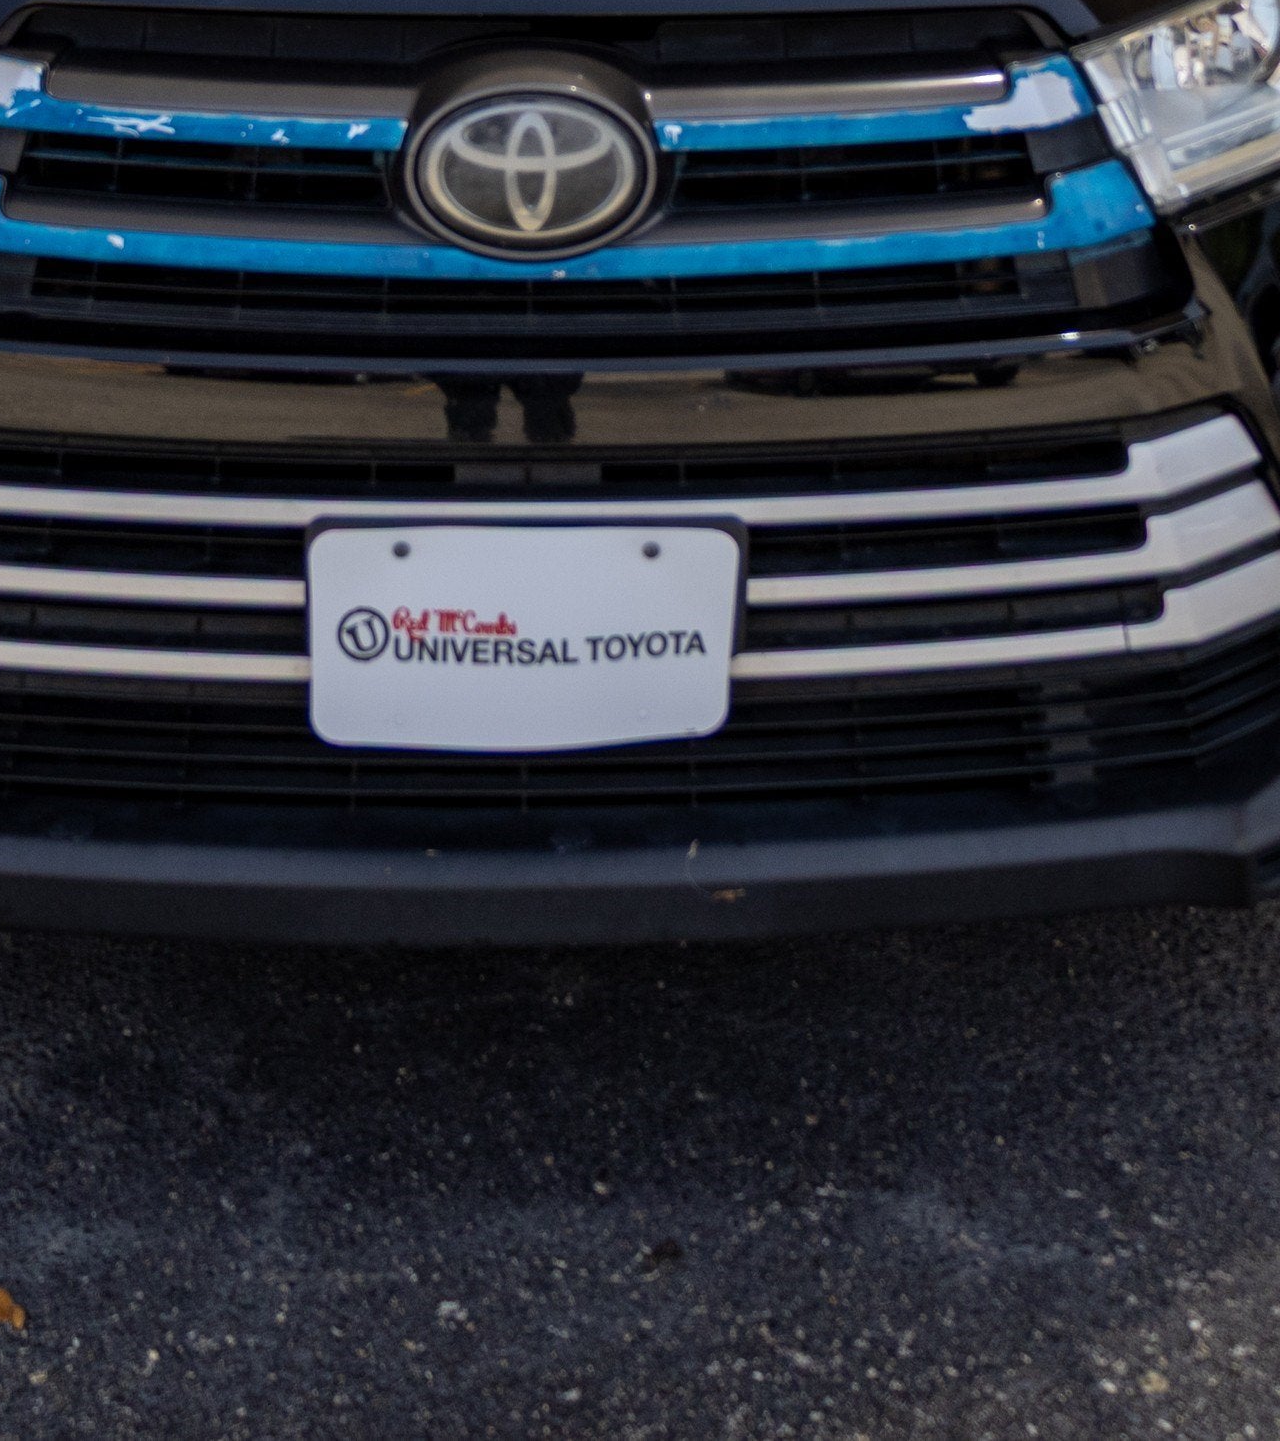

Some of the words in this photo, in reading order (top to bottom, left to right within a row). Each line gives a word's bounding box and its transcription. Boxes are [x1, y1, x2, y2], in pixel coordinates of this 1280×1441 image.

[393, 606, 430, 642] Red
[394, 636, 579, 665] UNIVERSAL
[586, 629, 707, 662] TOYOTA
